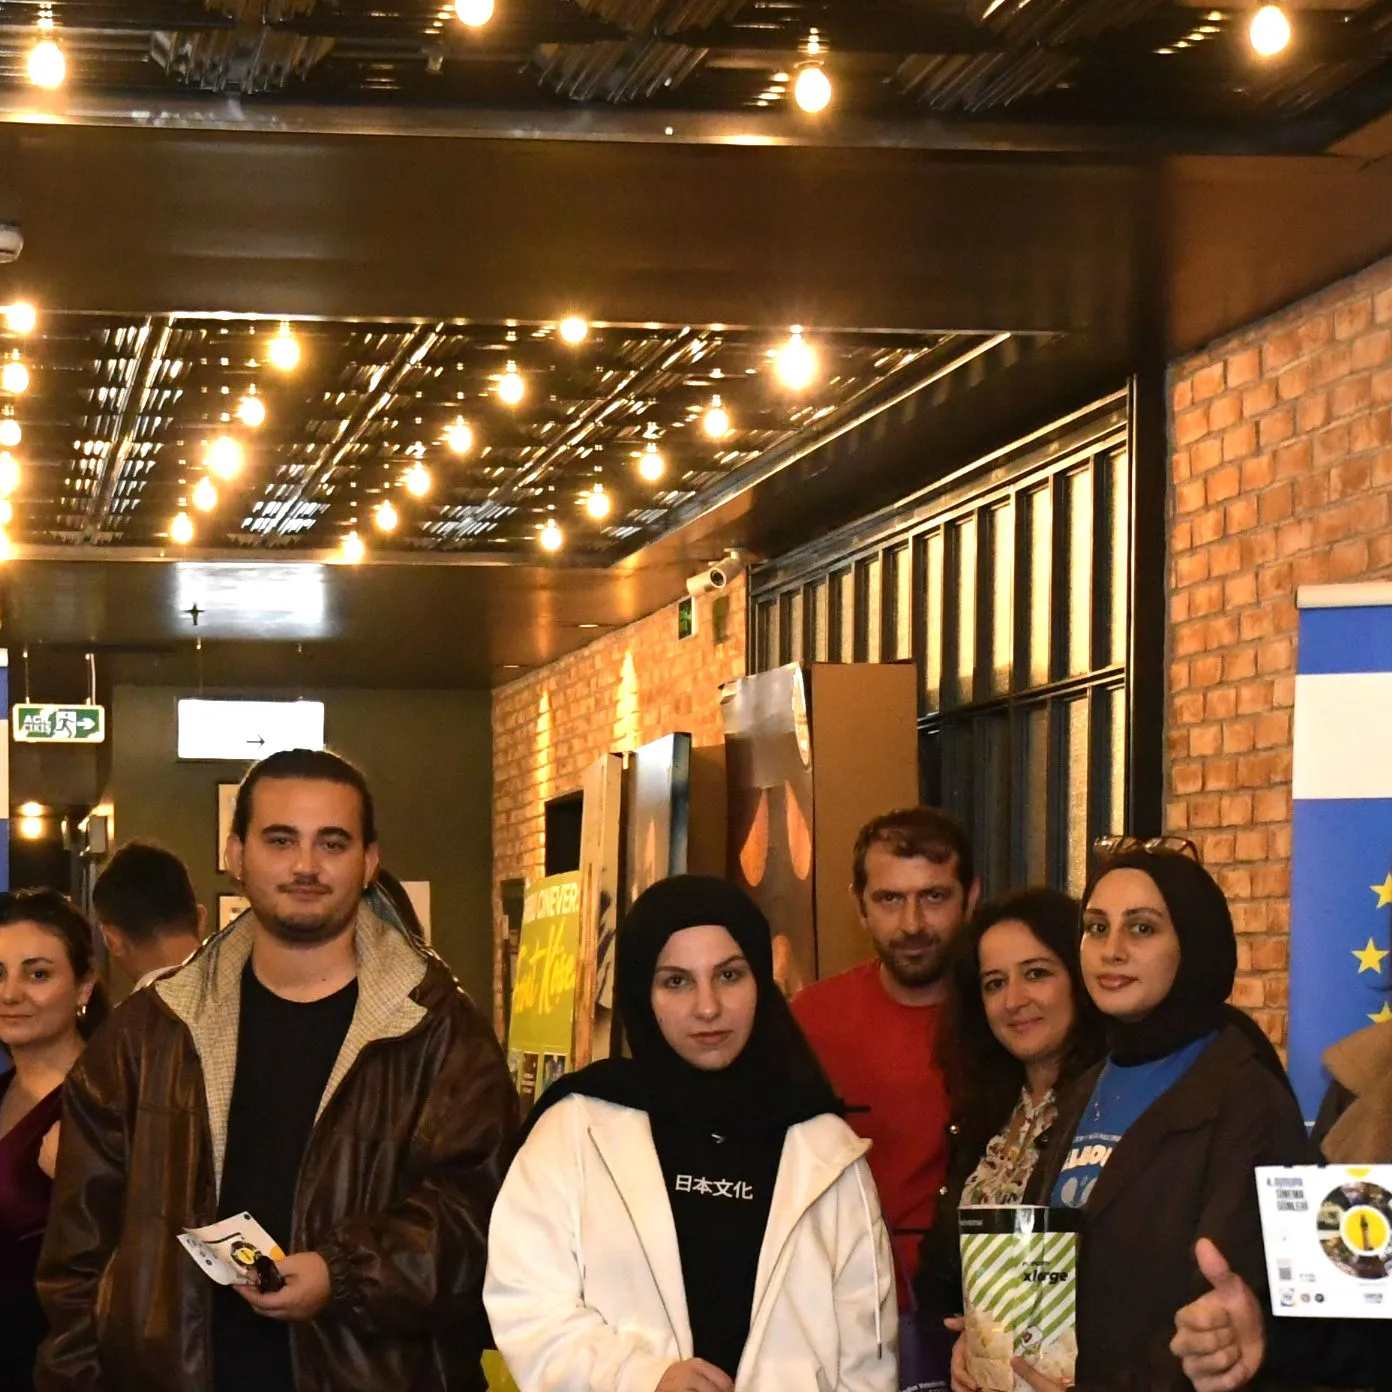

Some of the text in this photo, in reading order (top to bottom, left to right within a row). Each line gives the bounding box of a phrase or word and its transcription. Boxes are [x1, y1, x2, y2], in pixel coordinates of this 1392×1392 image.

[675, 1174, 754, 1200] 日本文化
[1023, 1269, 1068, 1285] xlarge
